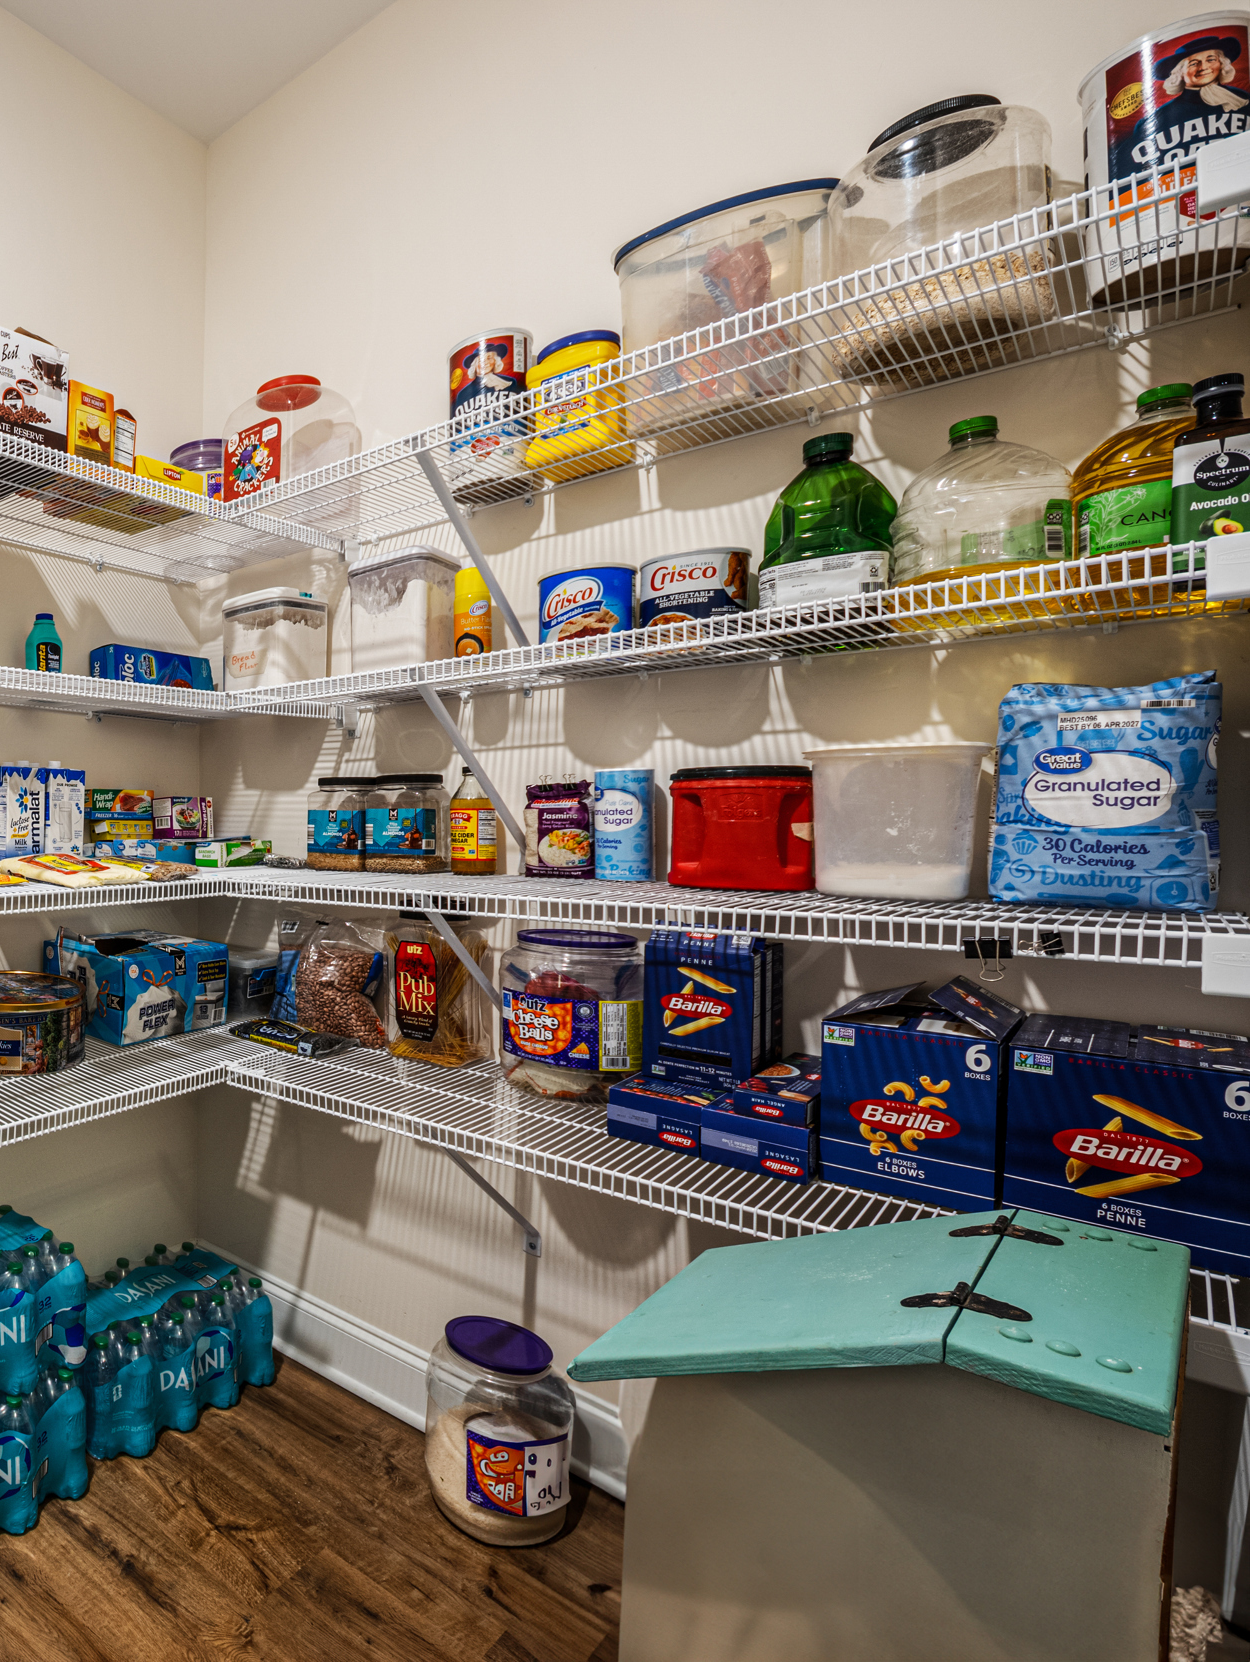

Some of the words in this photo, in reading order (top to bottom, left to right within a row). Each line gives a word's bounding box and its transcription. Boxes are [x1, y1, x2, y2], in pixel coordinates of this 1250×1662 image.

[0, 330, 11, 339] CUPS
[1, 344, 19, 363] Best
[14, 426, 44, 443] RESERVE
[231, 434, 259, 465] ANIMAL
[164, 470, 181, 480] LIPTON
[233, 456, 273, 494] CRACKERS
[1195, 466, 1250, 479] Spectrum
[1190, 496, 1238, 510] Avocado
[650, 565, 717, 592] Crisco
[546, 586, 594, 619] Crisco
[655, 590, 715, 603] ALL-VEGETABLE
[659, 596, 709, 608] SHORTENING
[232, 652, 256, 665] Bread
[1059, 723, 1080, 731] BEST
[1121, 720, 1140, 728] 2027
[1060, 715, 1098, 724] MHD25096
[1136, 720, 1213, 747] Sugar
[1039, 753, 1082, 764] Great
[1049, 761, 1081, 770] Value
[1034, 779, 1161, 792] Granulated
[95, 800, 114, 809] Wrap
[1092, 793, 1161, 810] Sugar
[29, 790, 40, 854] armalat
[603, 816, 633, 826] Sugar
[14, 838, 27, 846] Milk
[1042, 836, 1066, 852] 30
[1070, 838, 1150, 855] Calories
[1051, 852, 1074, 865] Per
[1077, 854, 1136, 870] Serving
[1037, 866, 1145, 893] Dusting
[407, 944, 423, 955] utz
[681, 957, 713, 966] PENNE
[400, 971, 435, 997] Pub
[139, 998, 175, 1020] POWER
[399, 990, 436, 1016] Mix
[526, 998, 547, 1012] utz
[669, 997, 726, 1015] Barilla
[142, 1014, 169, 1032] FLEX
[512, 1010, 559, 1030] Cheese
[518, 1024, 553, 1042] Balls
[965, 1044, 991, 1072] 6
[700, 1066, 715, 1074] 11-12
[964, 1072, 991, 1081] BOXES
[1069, 1057, 1125, 1070] BARILLA
[1135, 1066, 1194, 1080] CLASSIC
[1224, 1081, 1250, 1112] 6
[861, 1105, 946, 1133] Barilla
[662, 1133, 691, 1145] Barilla
[1070, 1135, 1181, 1171] Barilla
[764, 1160, 798, 1174] Barilla
[878, 1162, 925, 1179] ELBOWS
[1097, 1210, 1146, 1228] PENNE
[114, 1275, 176, 1304] DASANI
[160, 1346, 225, 1395] DASANI
